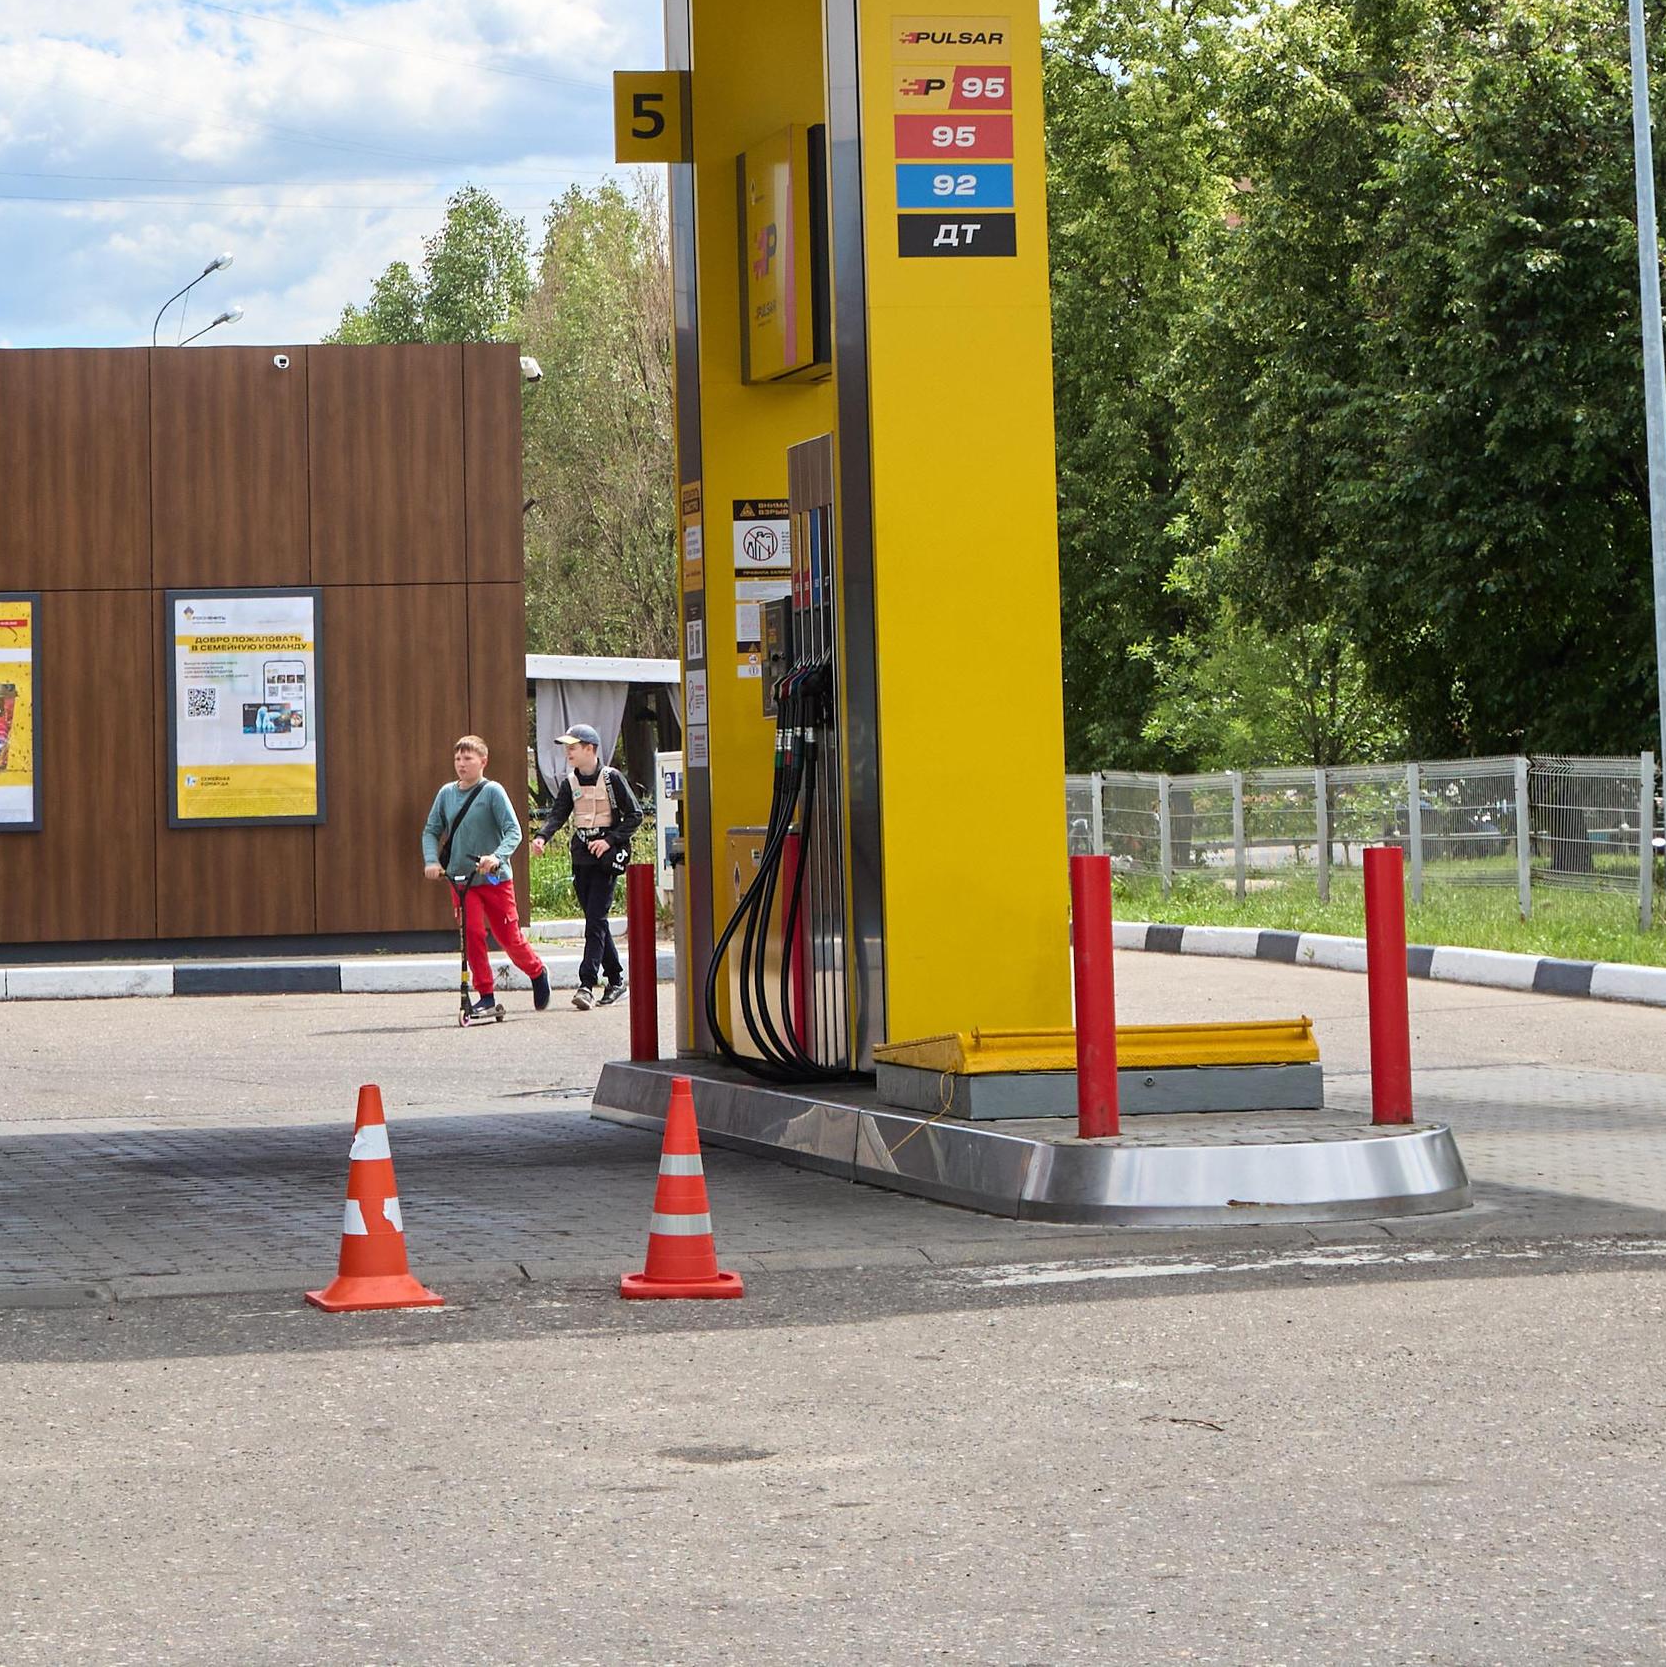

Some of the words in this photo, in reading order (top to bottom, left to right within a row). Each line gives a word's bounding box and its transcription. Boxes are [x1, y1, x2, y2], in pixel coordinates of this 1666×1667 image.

[915, 32, 1003, 45] PULSAR
[961, 77, 1005, 98] 95
[632, 93, 665, 139] 5
[932, 126, 976, 147] 95
[932, 174, 977, 196] 92
[933, 223, 981, 247] ДТ
[195, 636, 230, 644] ДОБРО
[200, 643, 256, 651] СЕМЕЙНУЮ
